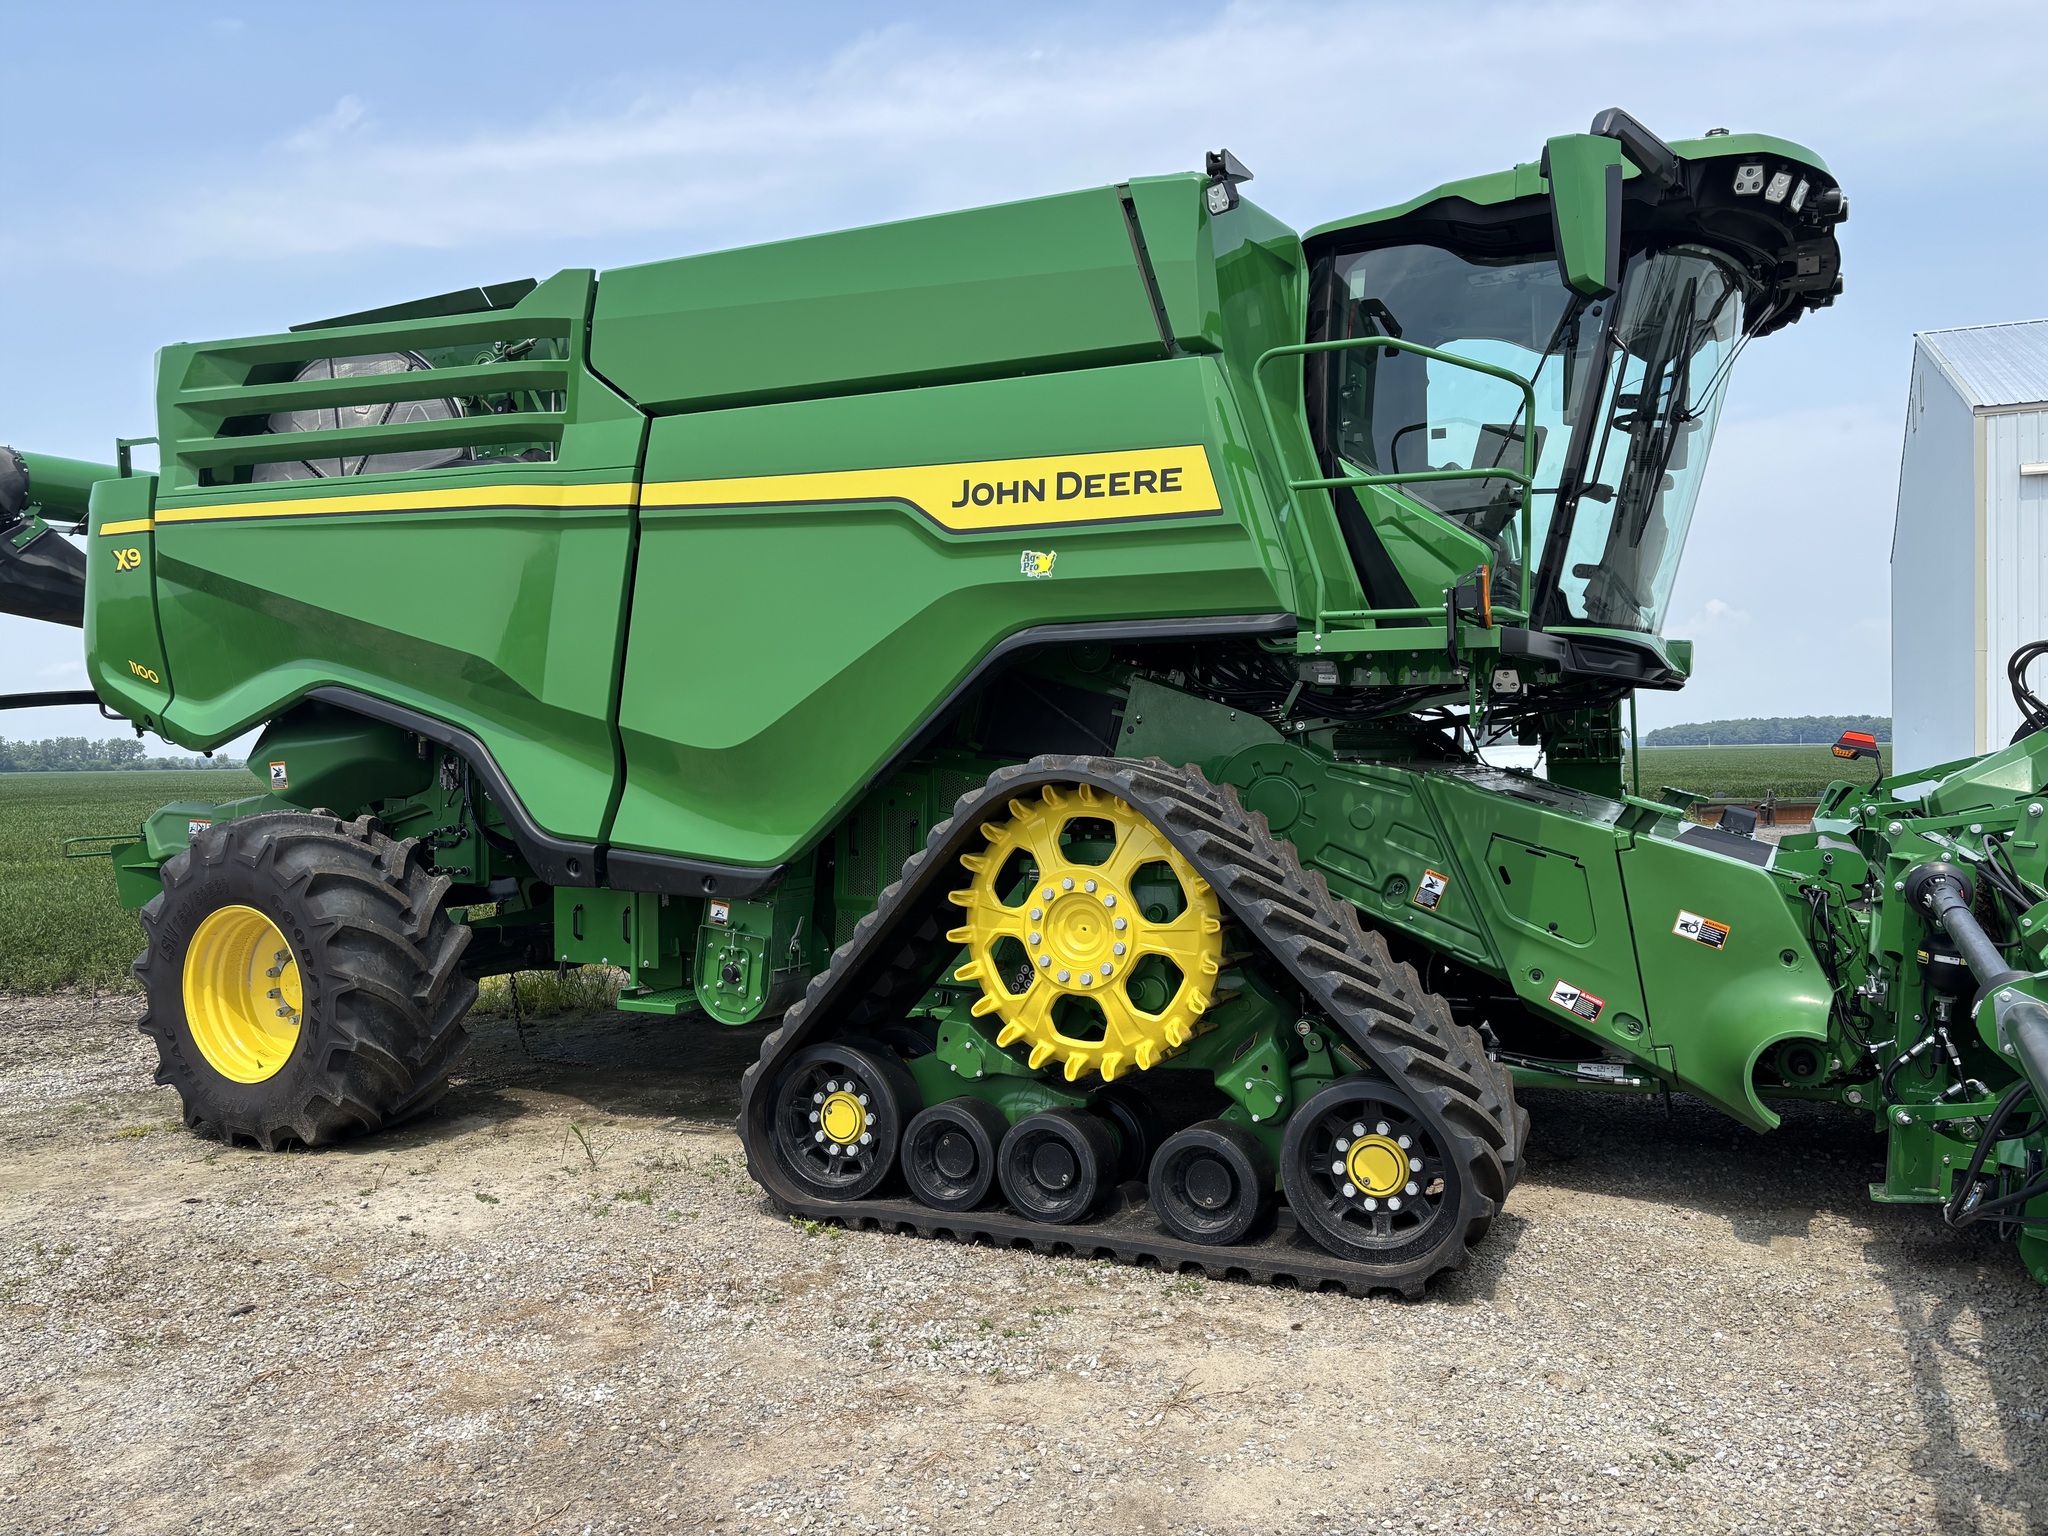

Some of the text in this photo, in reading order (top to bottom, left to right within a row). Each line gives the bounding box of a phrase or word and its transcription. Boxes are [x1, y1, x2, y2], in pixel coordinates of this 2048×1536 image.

[952, 467, 1183, 508] JOHN DEERE
[112, 548, 142, 573] X9
[1022, 562, 1039, 572] Pro
[128, 659, 160, 684] 1100
[271, 894, 322, 1086] GOODYEAR
[1585, 994, 1603, 1005] DANGER
